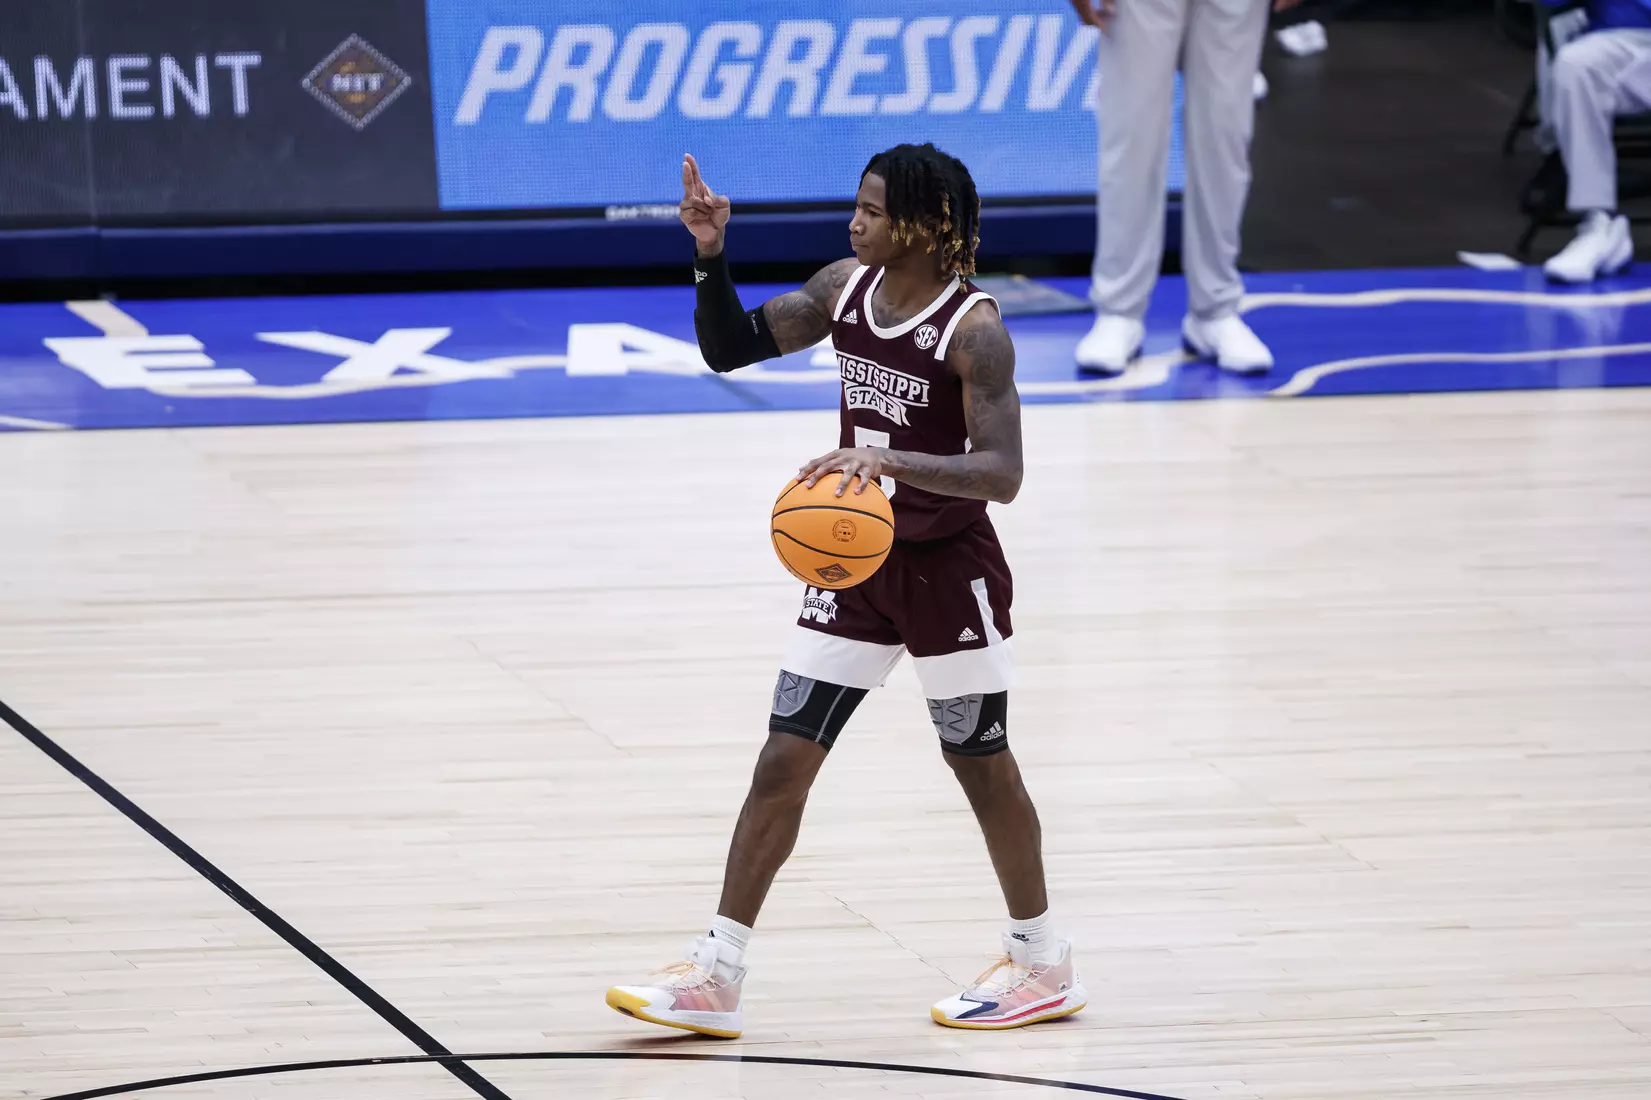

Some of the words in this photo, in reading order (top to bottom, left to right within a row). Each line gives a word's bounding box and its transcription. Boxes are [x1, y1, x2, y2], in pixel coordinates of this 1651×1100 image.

[453, 14, 1101, 125] PROGRESSIV
[916, 325, 937, 348] SEC
[849, 390, 895, 419] STATE
[805, 598, 829, 613] STATE
[958, 634, 979, 642] adidas
[980, 729, 1005, 741] adidas
